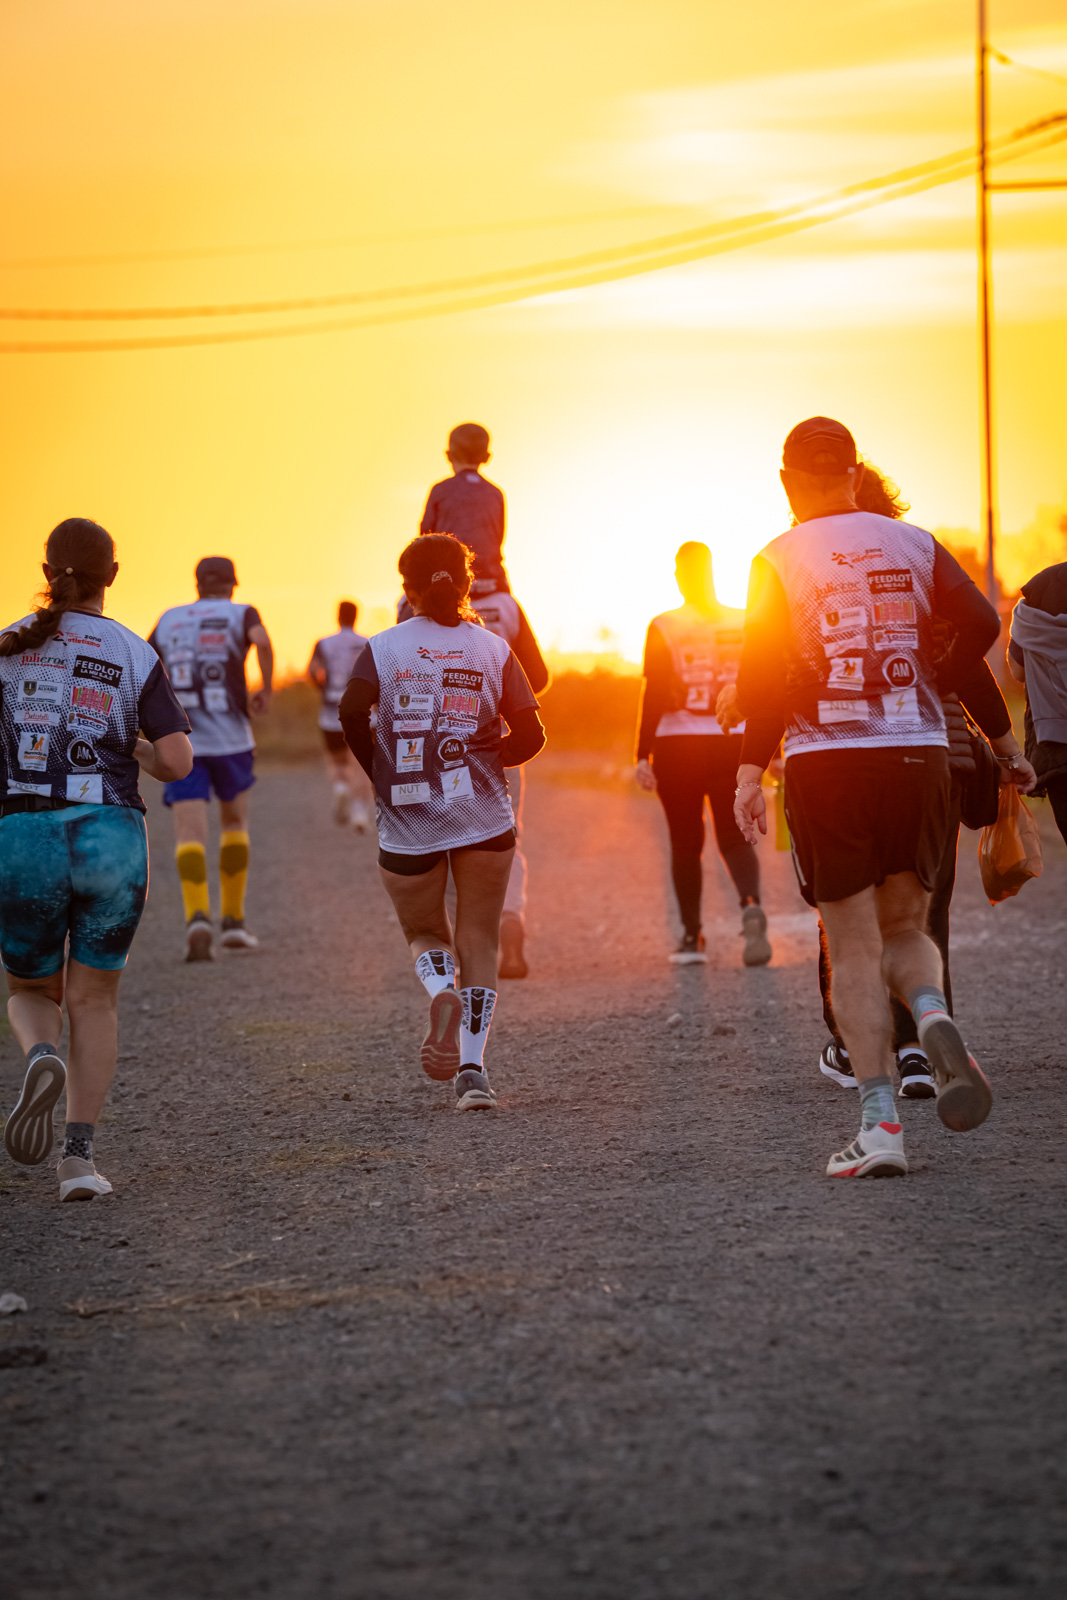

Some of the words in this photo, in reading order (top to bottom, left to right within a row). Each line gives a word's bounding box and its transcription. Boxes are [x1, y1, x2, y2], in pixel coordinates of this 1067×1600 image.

[868, 574, 912, 585] FEEDLOT
[67, 637, 100, 648] atletismo
[75, 660, 121, 678] FEEDLOT
[892, 663, 910, 678] AM
[443, 672, 483, 683] FEEDLOT
[76, 746, 91, 760] AM
[444, 742, 460, 754] AM
[399, 784, 420, 795] NUT
